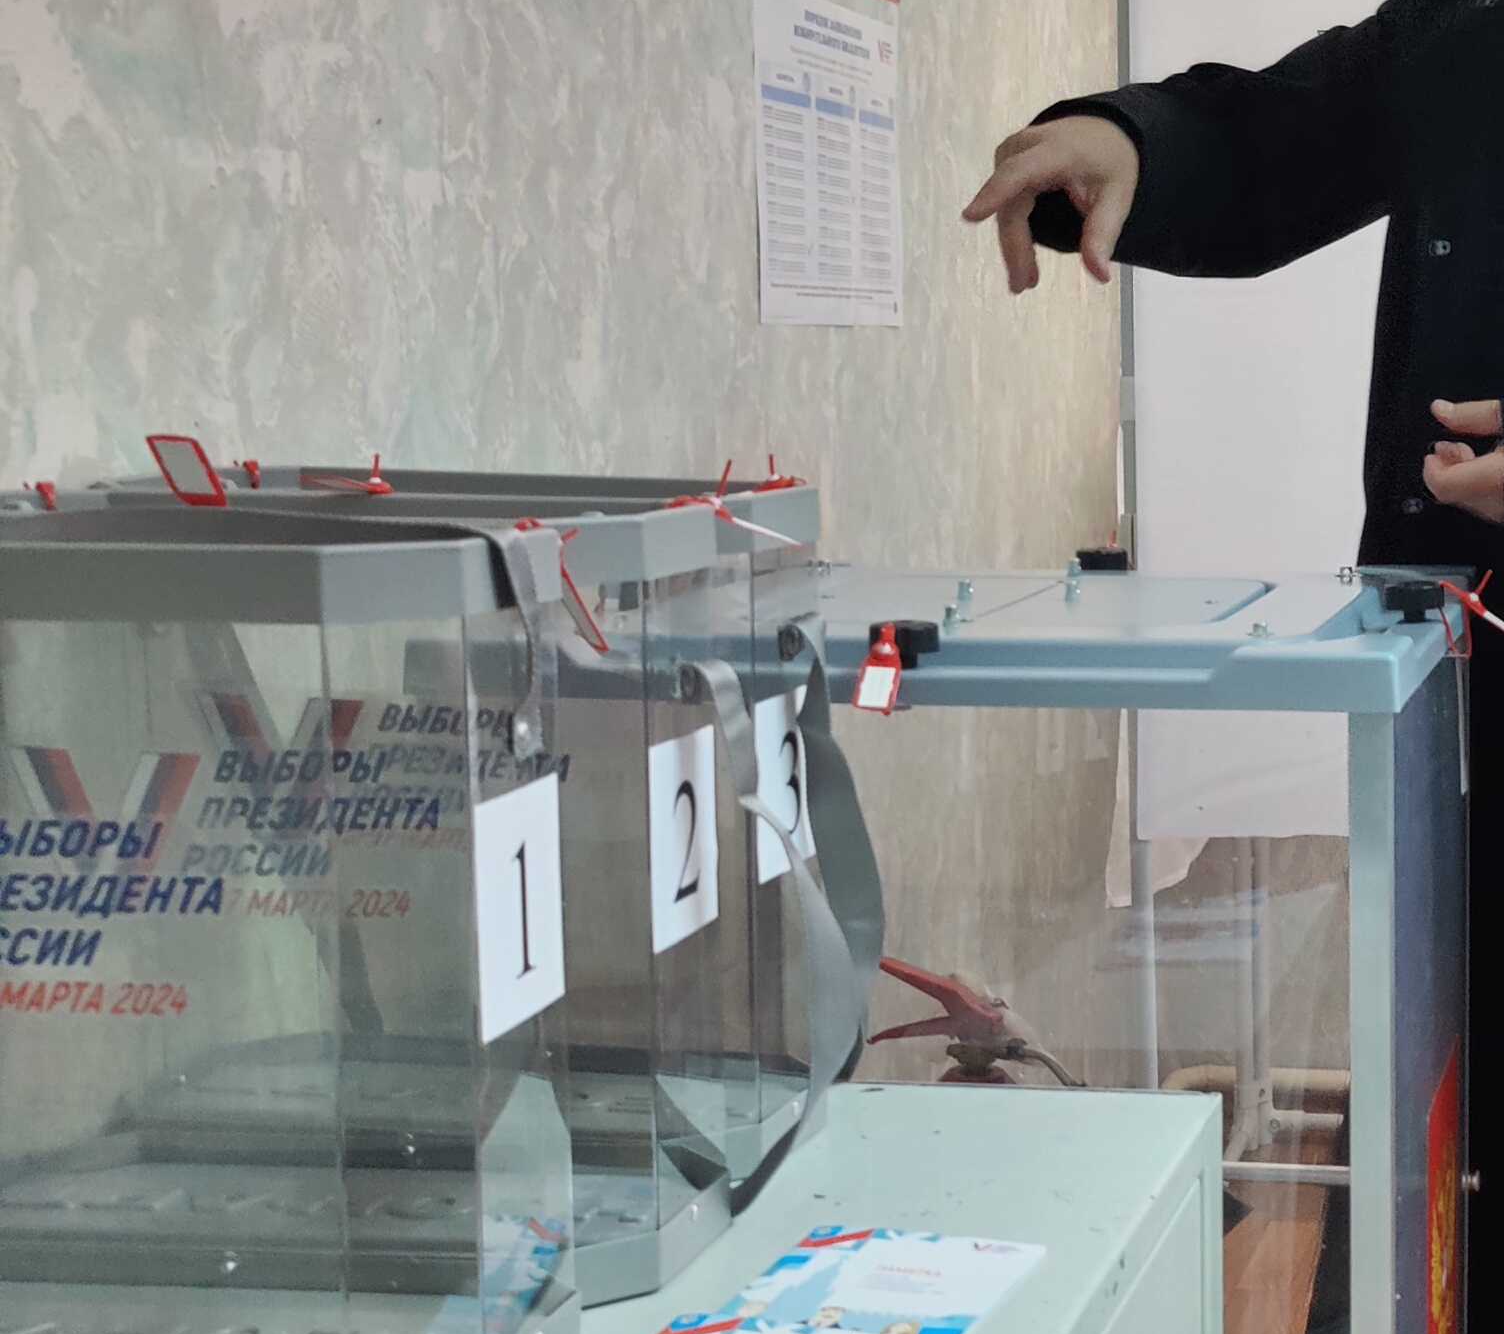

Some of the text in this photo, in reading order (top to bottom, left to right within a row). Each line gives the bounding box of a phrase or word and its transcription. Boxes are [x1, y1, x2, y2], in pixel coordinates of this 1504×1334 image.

[213, 748, 387, 785] ВЫБОРЫ
[779, 730, 803, 836] 3
[196, 795, 440, 836] ПРЕЗИДЕНТА
[182, 842, 333, 878] РОССИИ
[671, 778, 699, 905] 2
[0, 872, 224, 919] ЕЗИДЕНТА
[346, 887, 411, 918] 2024
[511, 837, 536, 981] 1
[0, 979, 189, 1017] МАРТА 2024
